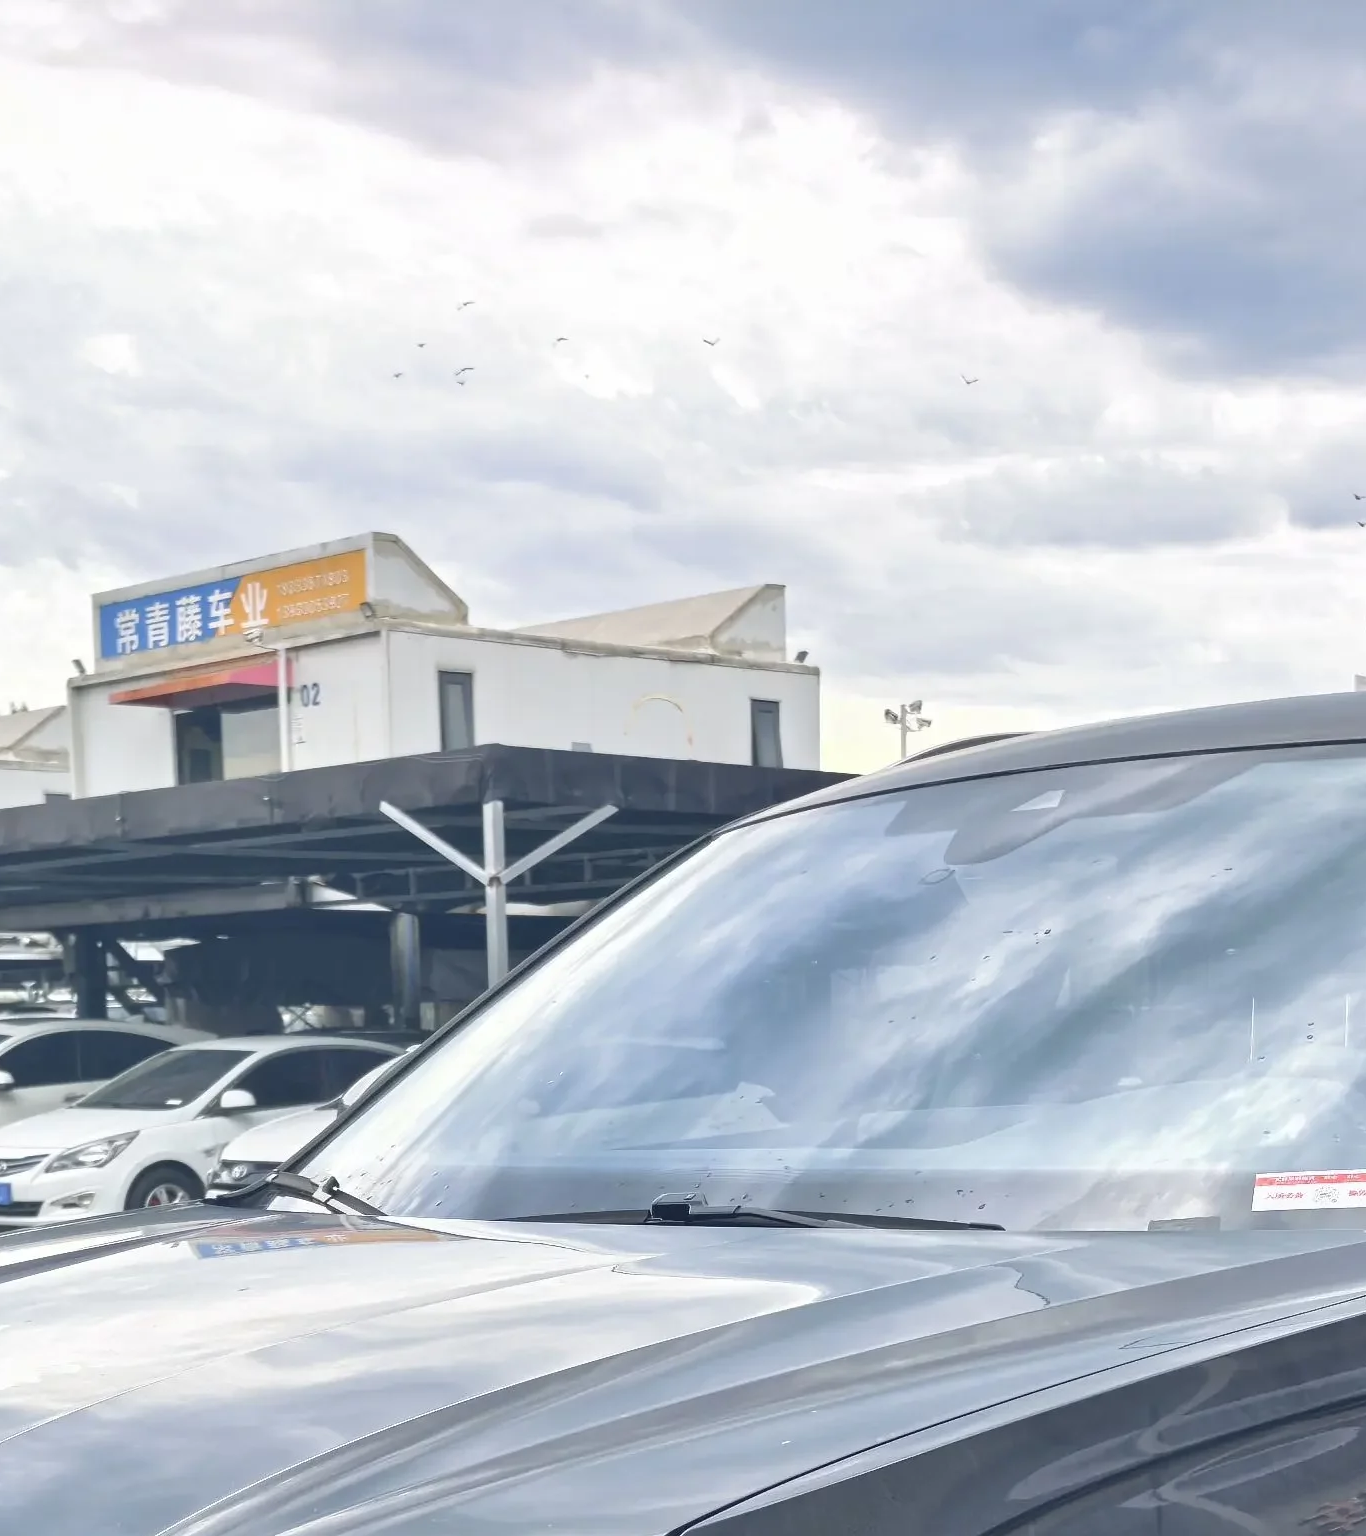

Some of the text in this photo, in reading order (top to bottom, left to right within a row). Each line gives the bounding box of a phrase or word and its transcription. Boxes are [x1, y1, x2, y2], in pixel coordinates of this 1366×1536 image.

[113, 581, 269, 654] 常青藤车业
[300, 682, 321, 707] 02
